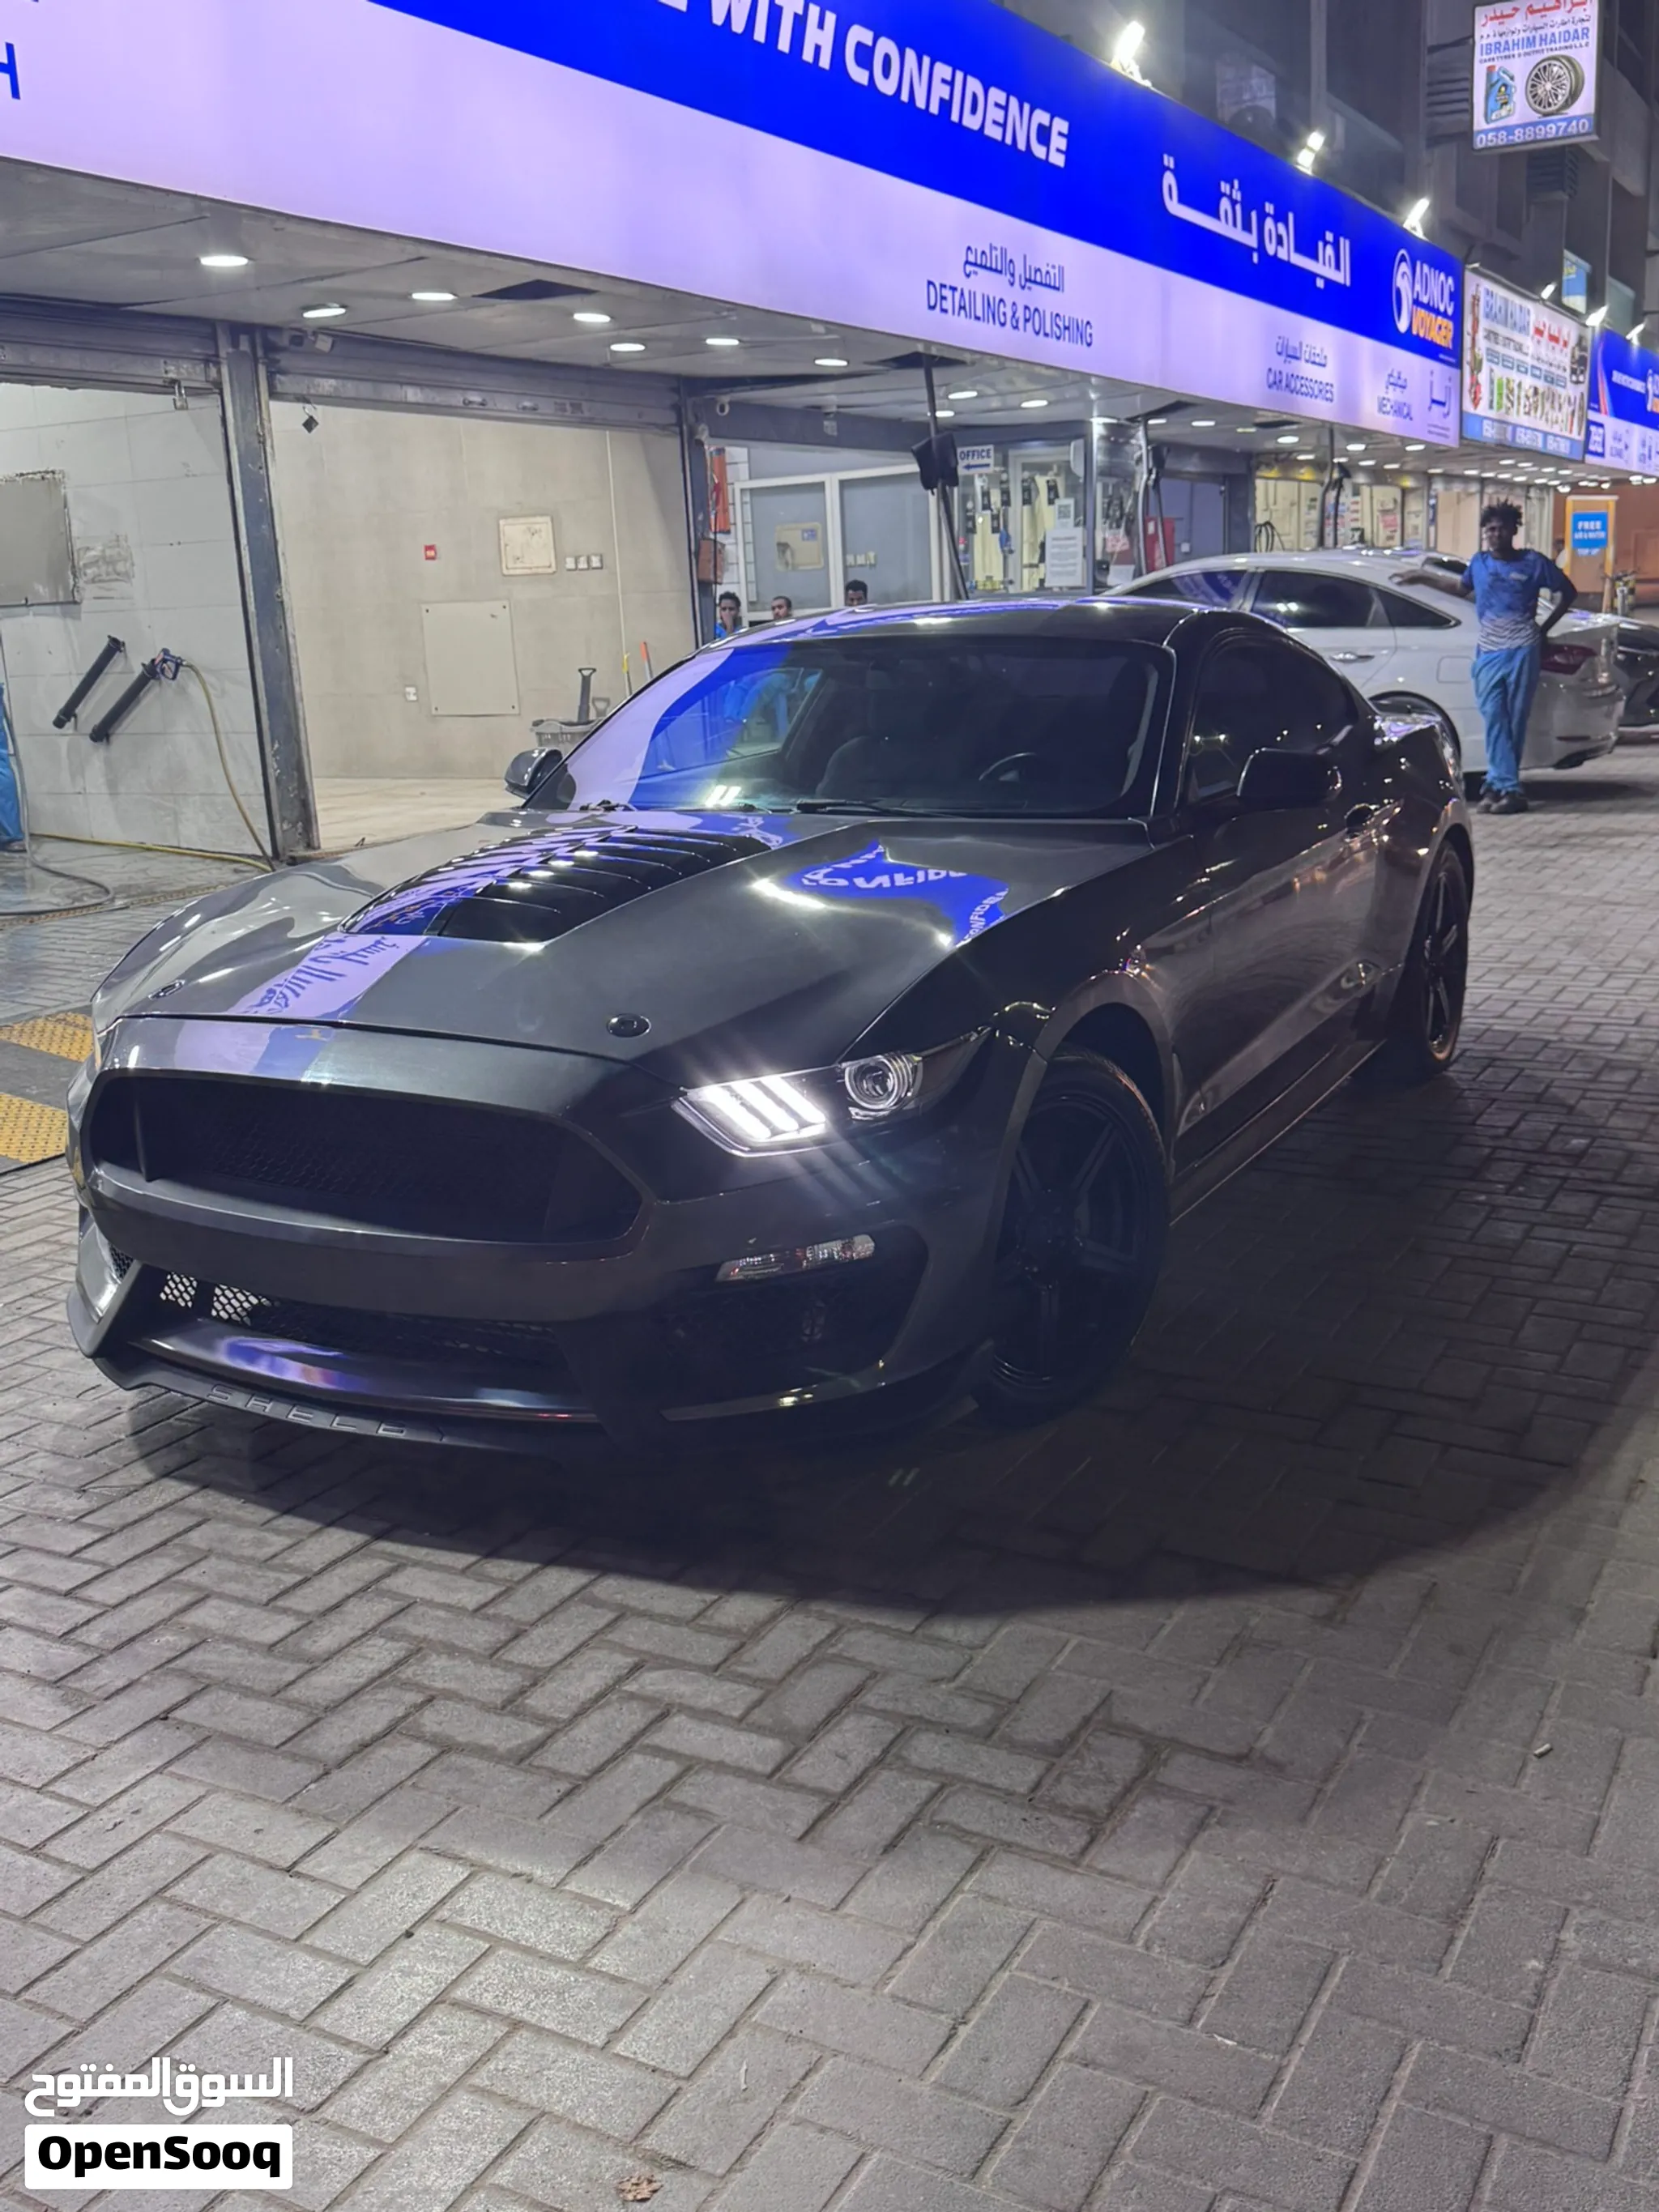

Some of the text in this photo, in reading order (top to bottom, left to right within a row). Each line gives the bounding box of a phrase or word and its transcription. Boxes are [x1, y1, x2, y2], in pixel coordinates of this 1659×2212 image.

[1480, 27, 1590, 57] IBRAHIM HAIDAR
[845, 23, 1069, 168] CONFIDENCE
[1476, 118, 1589, 148] 058-8899740
[1162, 153, 1350, 289] القيادة بثقة
[963, 242, 1064, 292] التفصيل والتلميع
[1414, 260, 1455, 317] ADNOC
[927, 279, 1093, 347] DETAILING & POLISHING
[1411, 305, 1453, 350] VOYAGER
[1266, 367, 1334, 403] CAR ACCESSORIES
[959, 448, 992, 461] OFFICE
